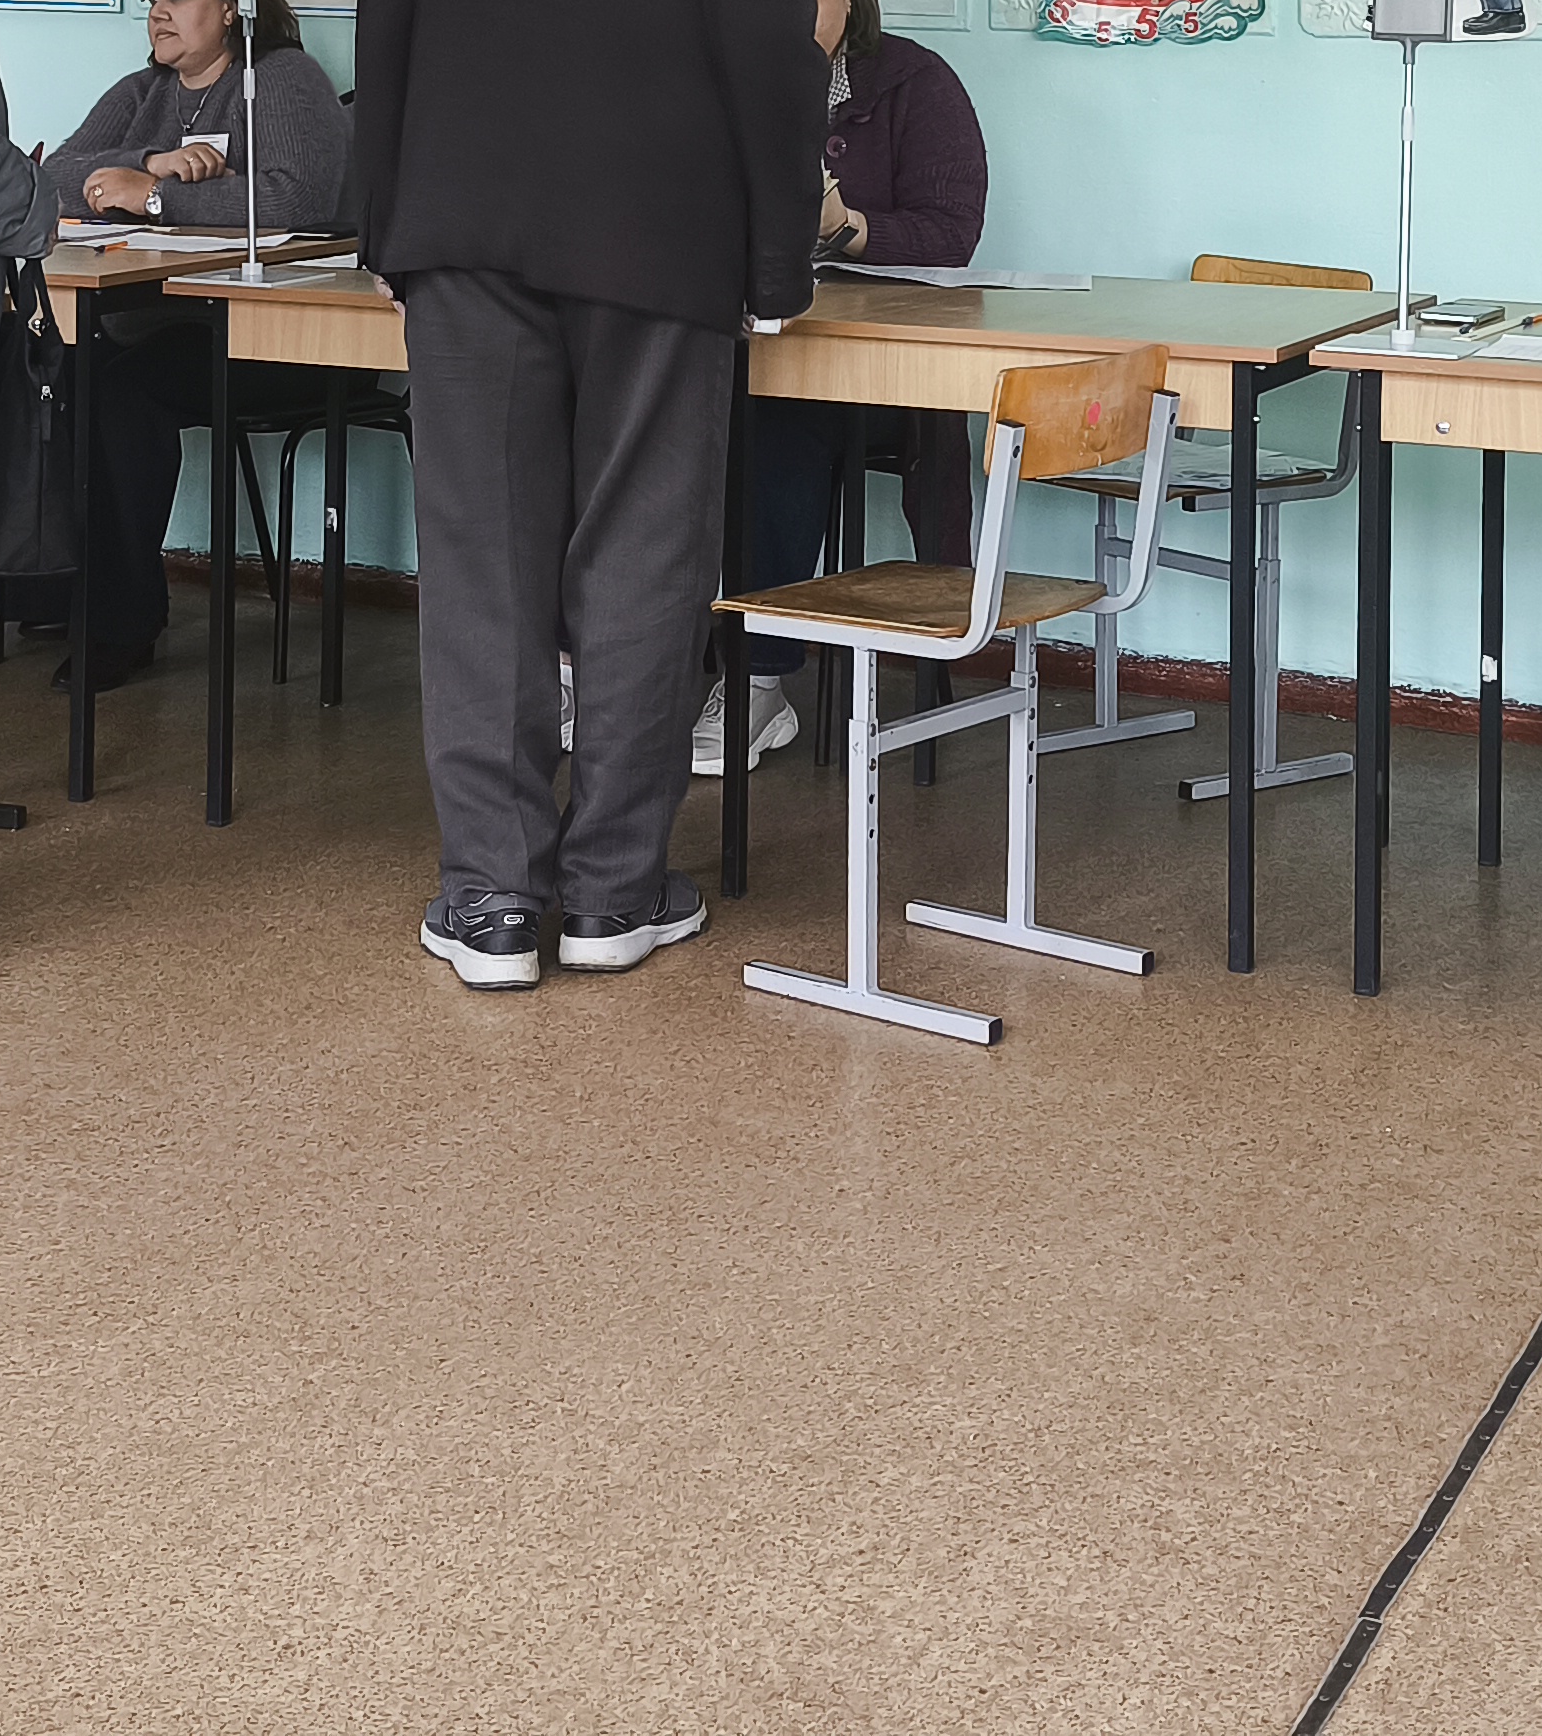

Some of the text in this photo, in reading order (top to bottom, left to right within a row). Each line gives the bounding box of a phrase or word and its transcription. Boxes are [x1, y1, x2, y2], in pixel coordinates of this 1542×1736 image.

[1096, 21, 1112, 43] 5
[1134, 7, 1160, 40] 5
[1182, 11, 1200, 34] 5
